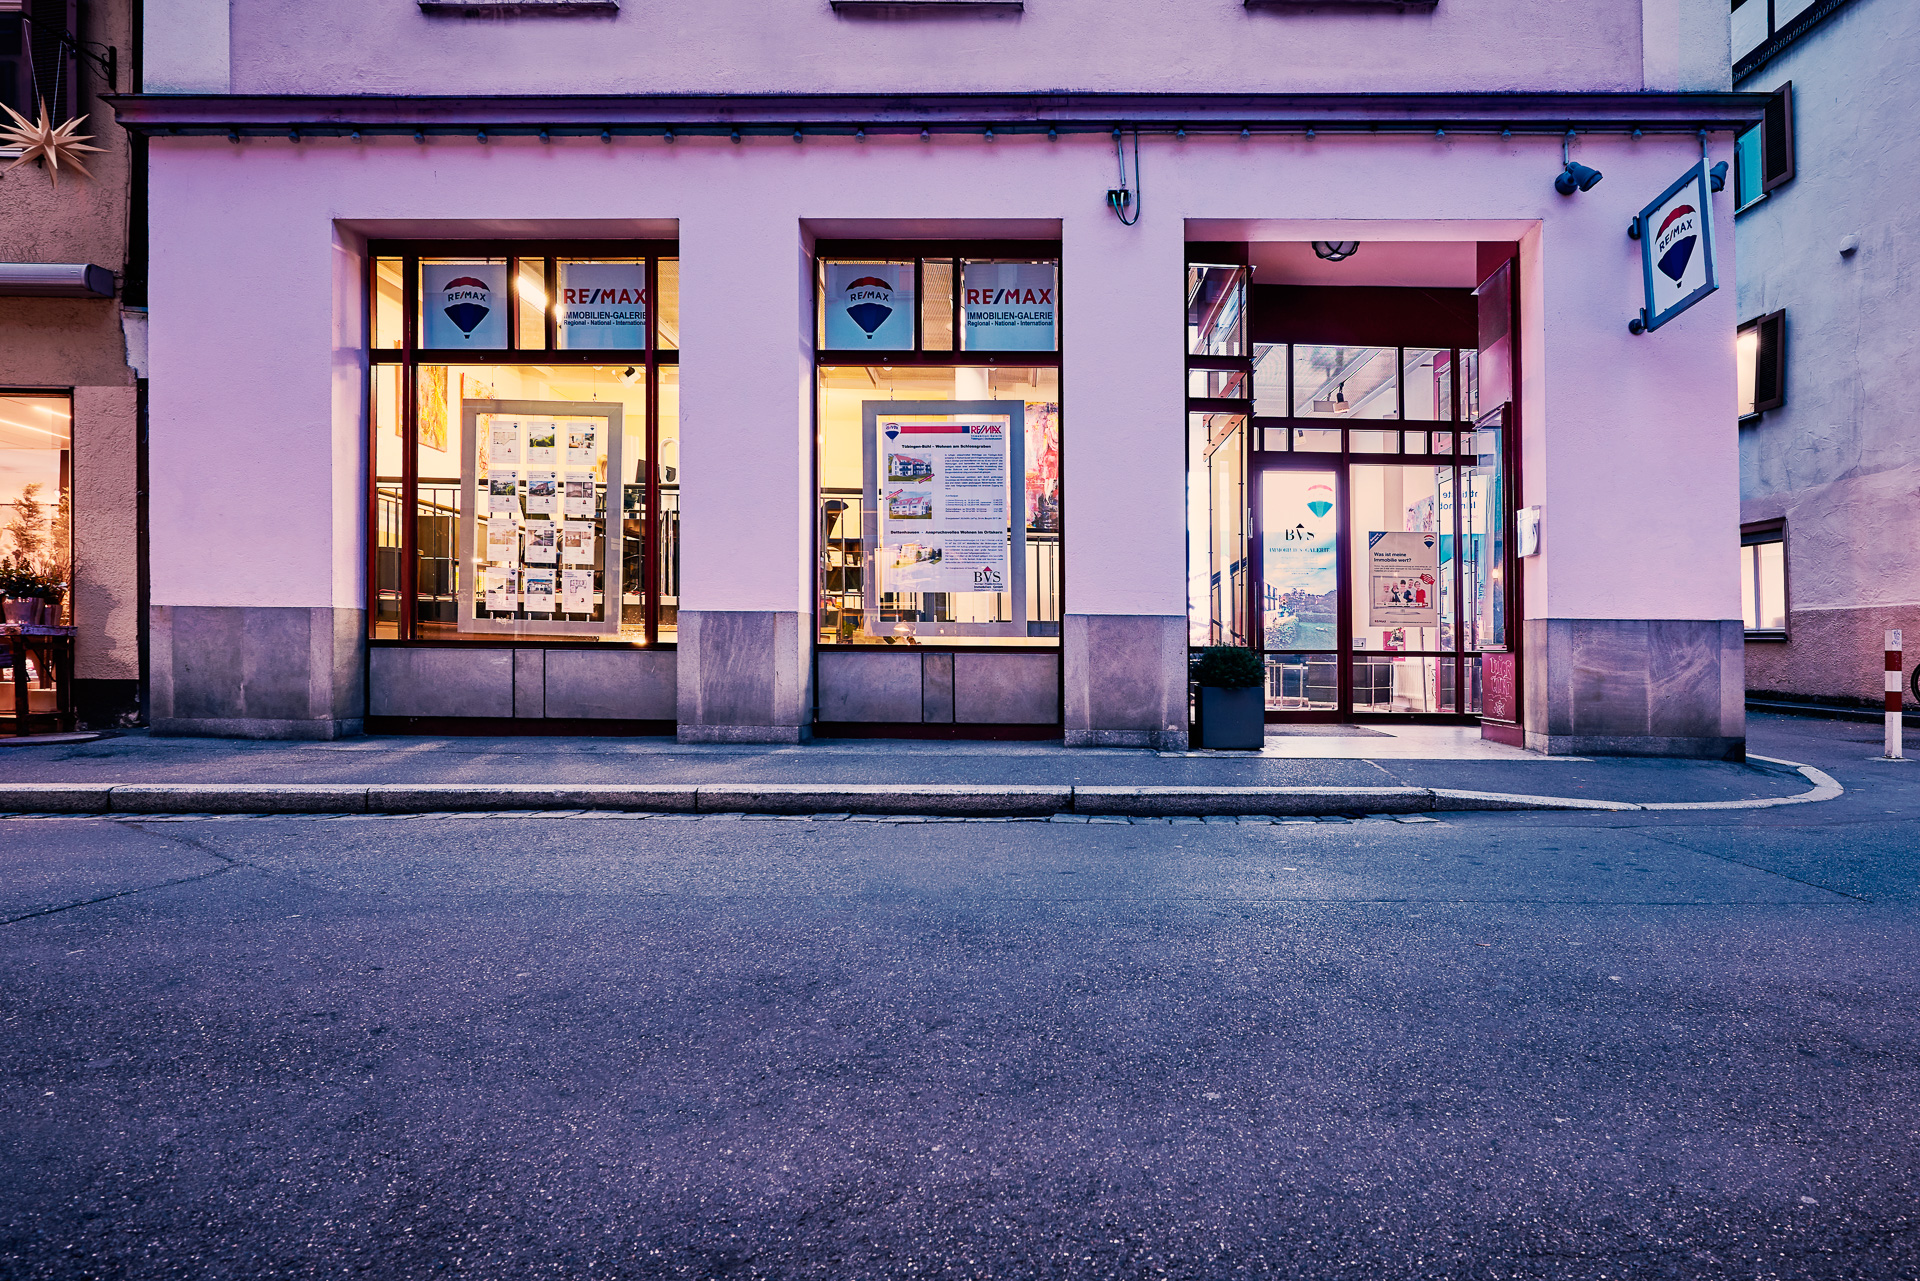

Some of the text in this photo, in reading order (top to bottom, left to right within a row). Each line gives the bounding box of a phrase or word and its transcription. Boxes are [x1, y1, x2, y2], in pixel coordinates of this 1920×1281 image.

[1659, 219, 1693, 253] RE/MAX
[447, 291, 486, 302] RE/MAX
[563, 288, 646, 305] RE/MAX
[850, 290, 889, 302] RE/MAX
[967, 288, 1053, 305] RE/MAX
[967, 312, 1053, 320] IMMOBILIEN-GALERIE
[970, 425, 1002, 434] RE/MAX
[1285, 529, 1315, 540] BVS
[974, 571, 1000, 582] BVS
